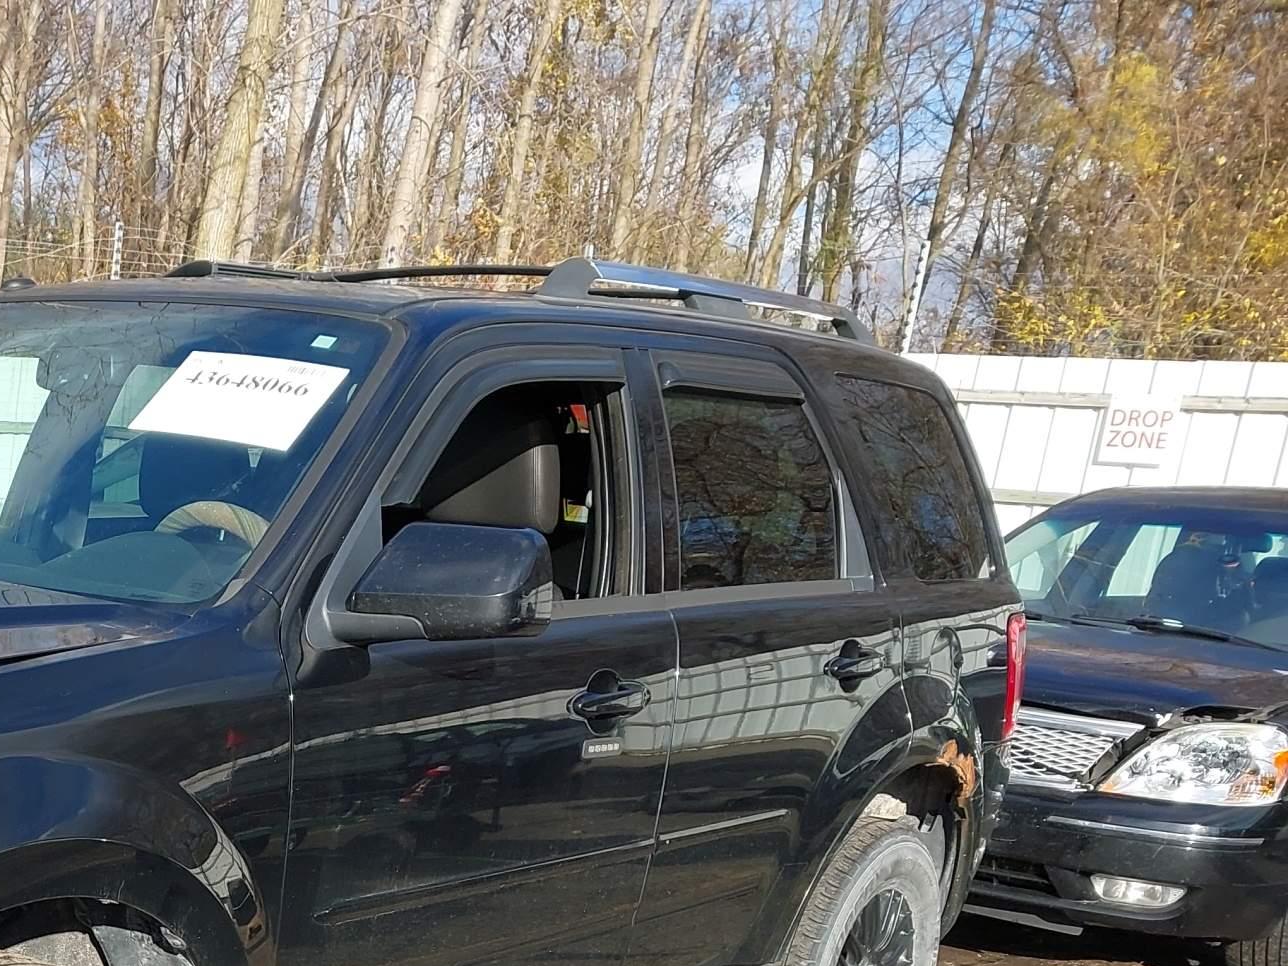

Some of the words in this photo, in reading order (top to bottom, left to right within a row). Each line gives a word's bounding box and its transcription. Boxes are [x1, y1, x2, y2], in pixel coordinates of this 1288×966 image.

[185, 370, 309, 396] 43648066
[1109, 408, 1174, 429] DROP
[1105, 430, 1169, 449] ZONE
